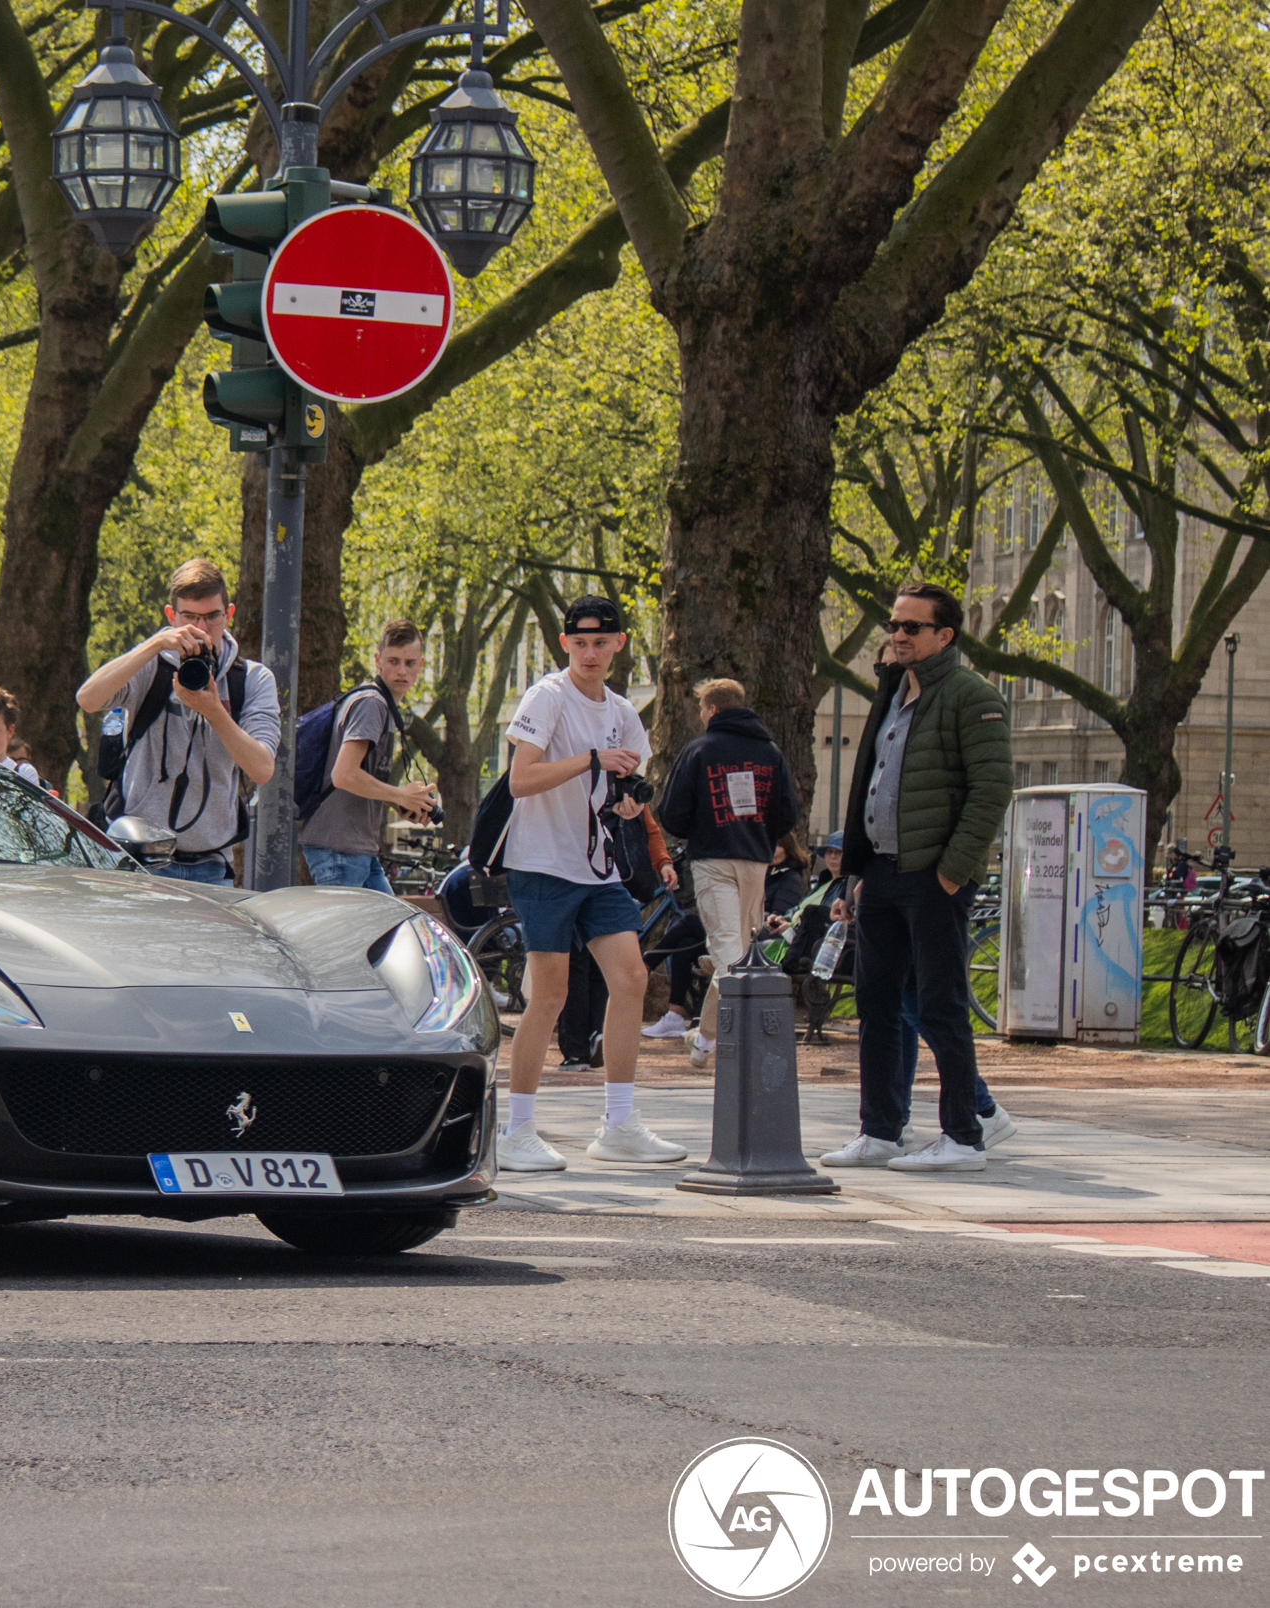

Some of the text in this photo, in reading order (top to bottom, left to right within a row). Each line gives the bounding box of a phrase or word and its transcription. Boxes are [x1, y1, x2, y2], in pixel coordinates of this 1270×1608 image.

[520, 714, 531, 725] SEA
[707, 763, 739, 779] Live
[1026, 818, 1052, 833] Dialoge
[1034, 833, 1064, 847] Wandel
[184, 1157, 328, 1189] D V 812
[163, 1177, 174, 1187] D
